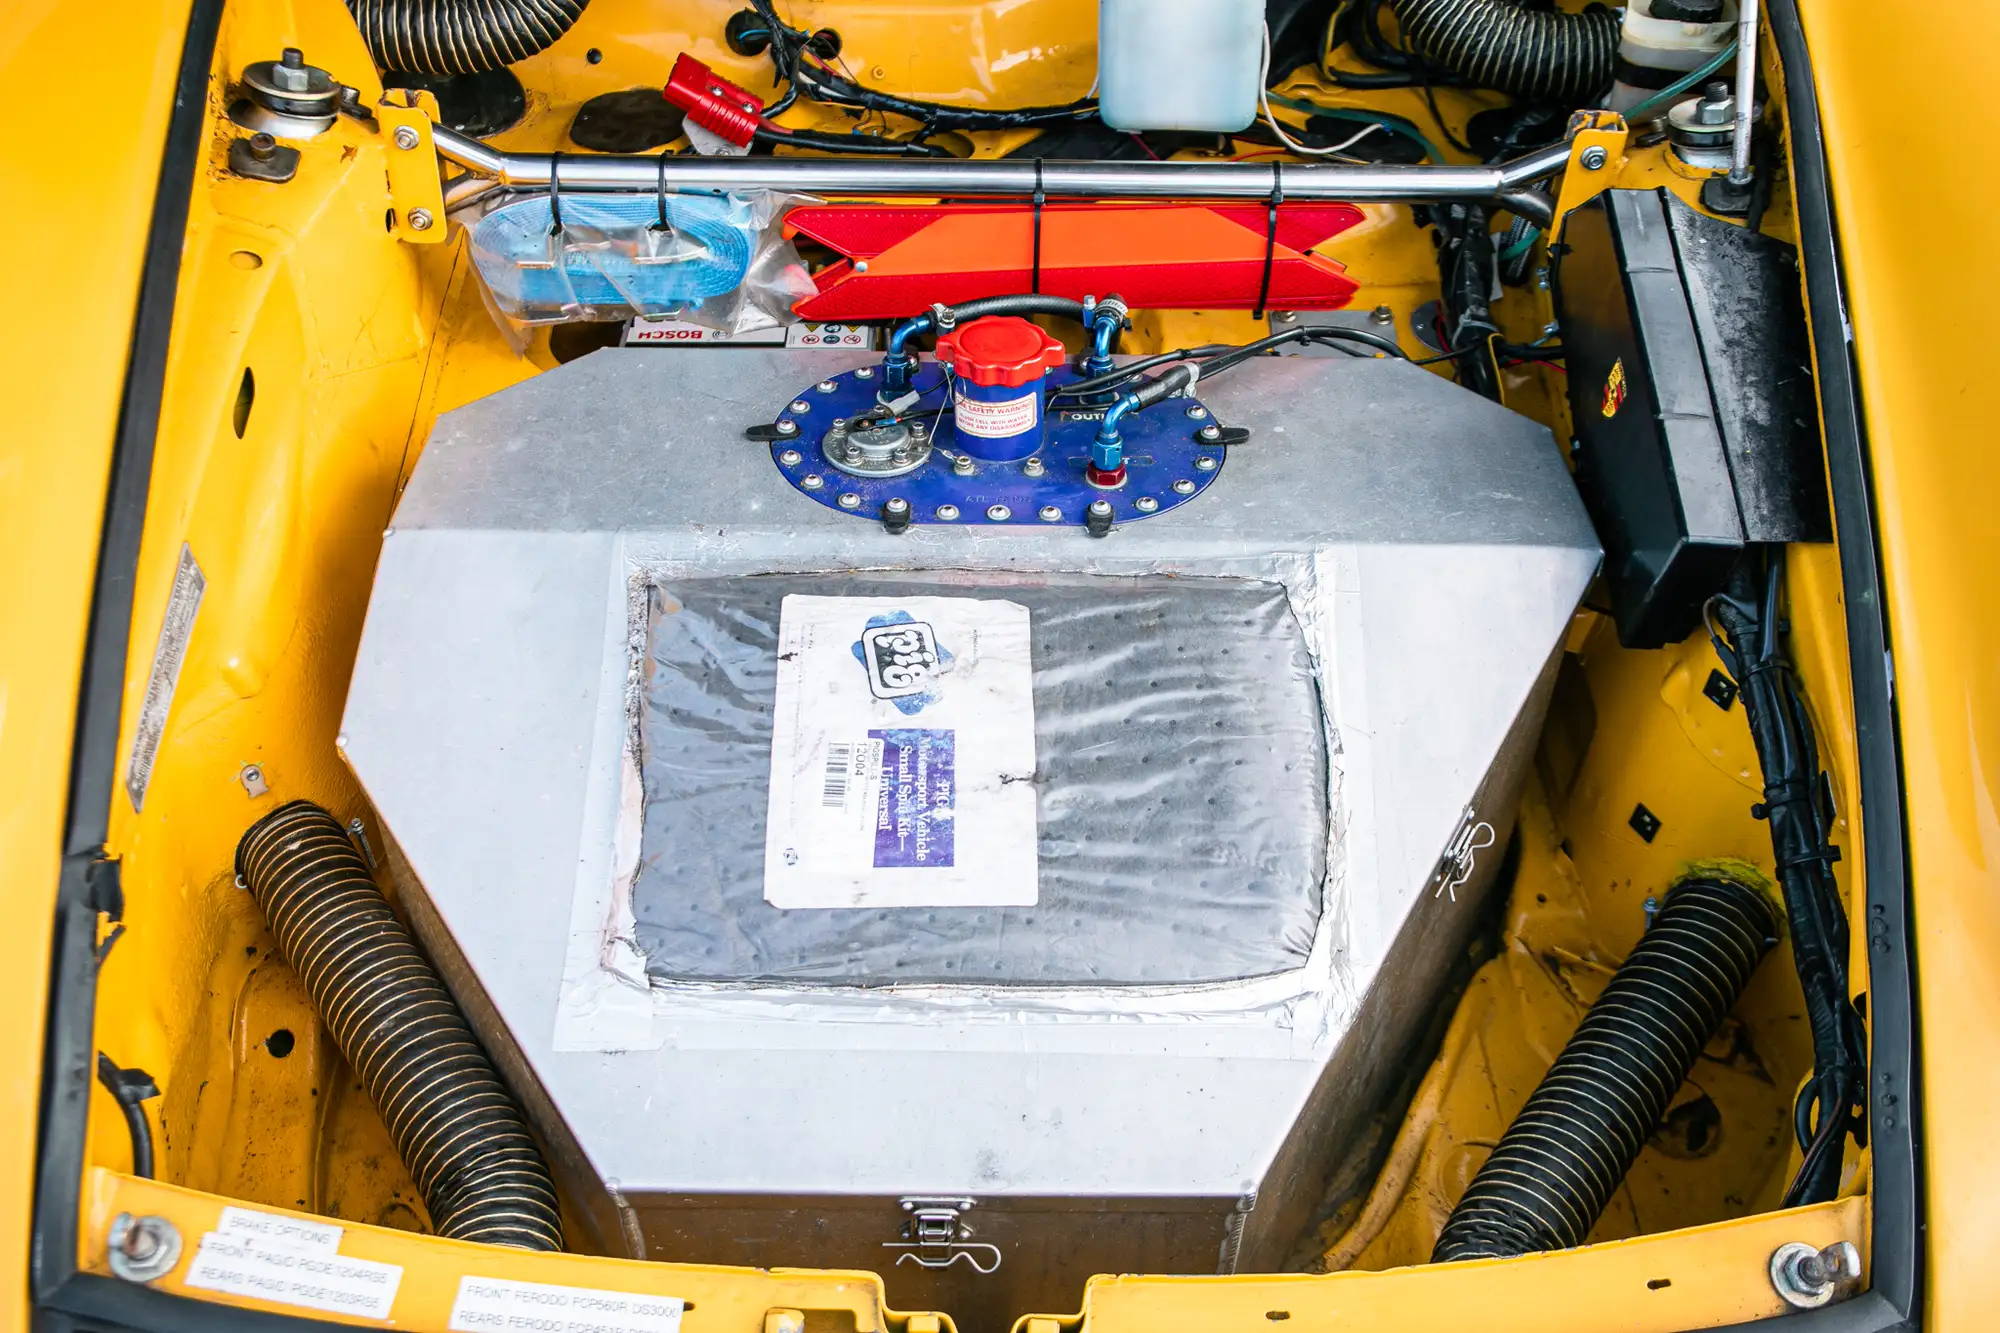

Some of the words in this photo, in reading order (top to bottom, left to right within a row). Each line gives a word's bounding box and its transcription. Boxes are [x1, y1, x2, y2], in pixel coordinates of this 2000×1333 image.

[638, 330, 703, 340] BOSCH
[968, 404, 995, 415] SAFETY
[997, 400, 1032, 415] WARNING
[975, 417, 989, 426] CELL
[991, 418, 1006, 426] WITH
[1008, 413, 1028, 424] WATER
[898, 745, 914, 783] Small
[914, 735, 932, 809] Motorsport
[878, 766, 894, 831] Universal
[935, 781, 950, 807] PIG
[916, 809, 931, 862] Vehicle
[229, 1216, 271, 1234] BRAKE
[274, 1223, 331, 1246] OPTIONS
[208, 1241, 254, 1258] FRONT
[256, 1250, 294, 1269] PAGID
[199, 1265, 243, 1284] REARS
[247, 1273, 285, 1293] PAGID
[466, 1284, 511, 1301] FRONT
[514, 1289, 569, 1307] FERODO
[459, 1309, 503, 1326] REARS
[508, 1315, 564, 1333] FERODO
